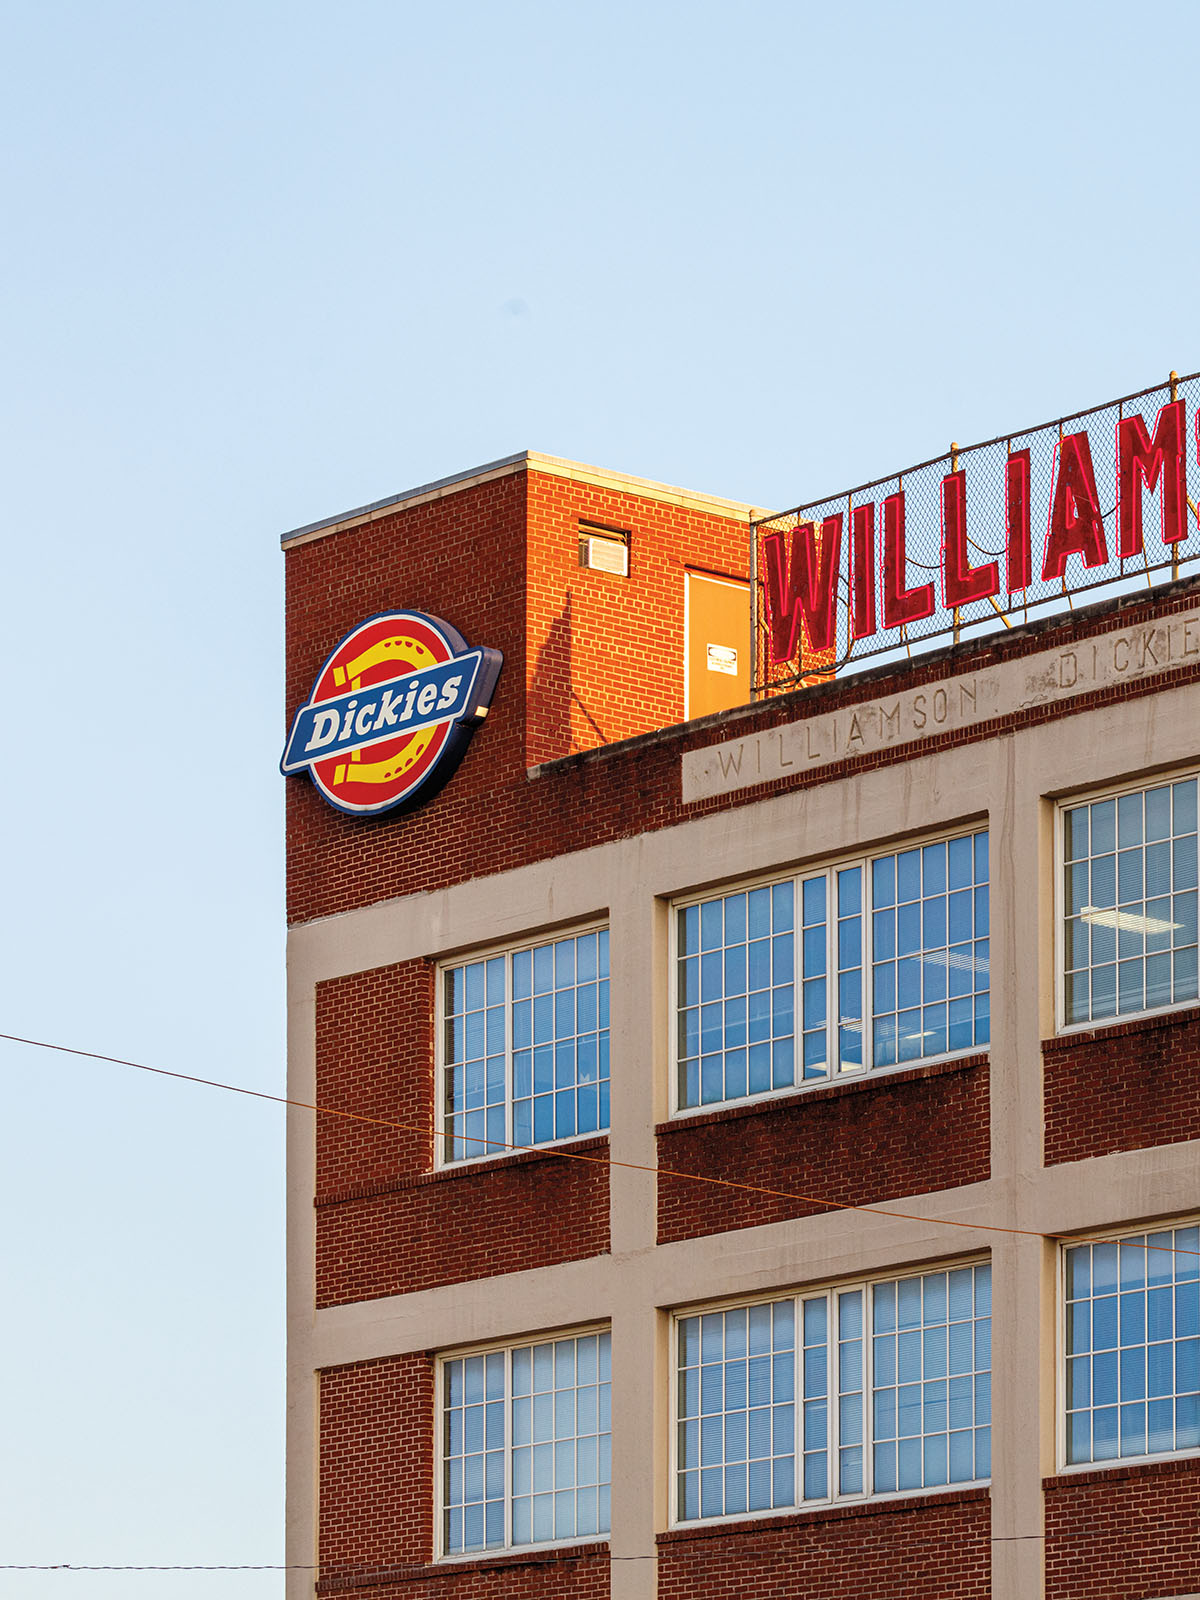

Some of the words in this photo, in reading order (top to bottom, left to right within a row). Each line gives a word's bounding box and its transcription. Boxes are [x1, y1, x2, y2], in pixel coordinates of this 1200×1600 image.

[303, 674, 463, 753] Dickies
[717, 677, 978, 779] WILLIAMSON
[1058, 617, 1199, 690] DICKIE
